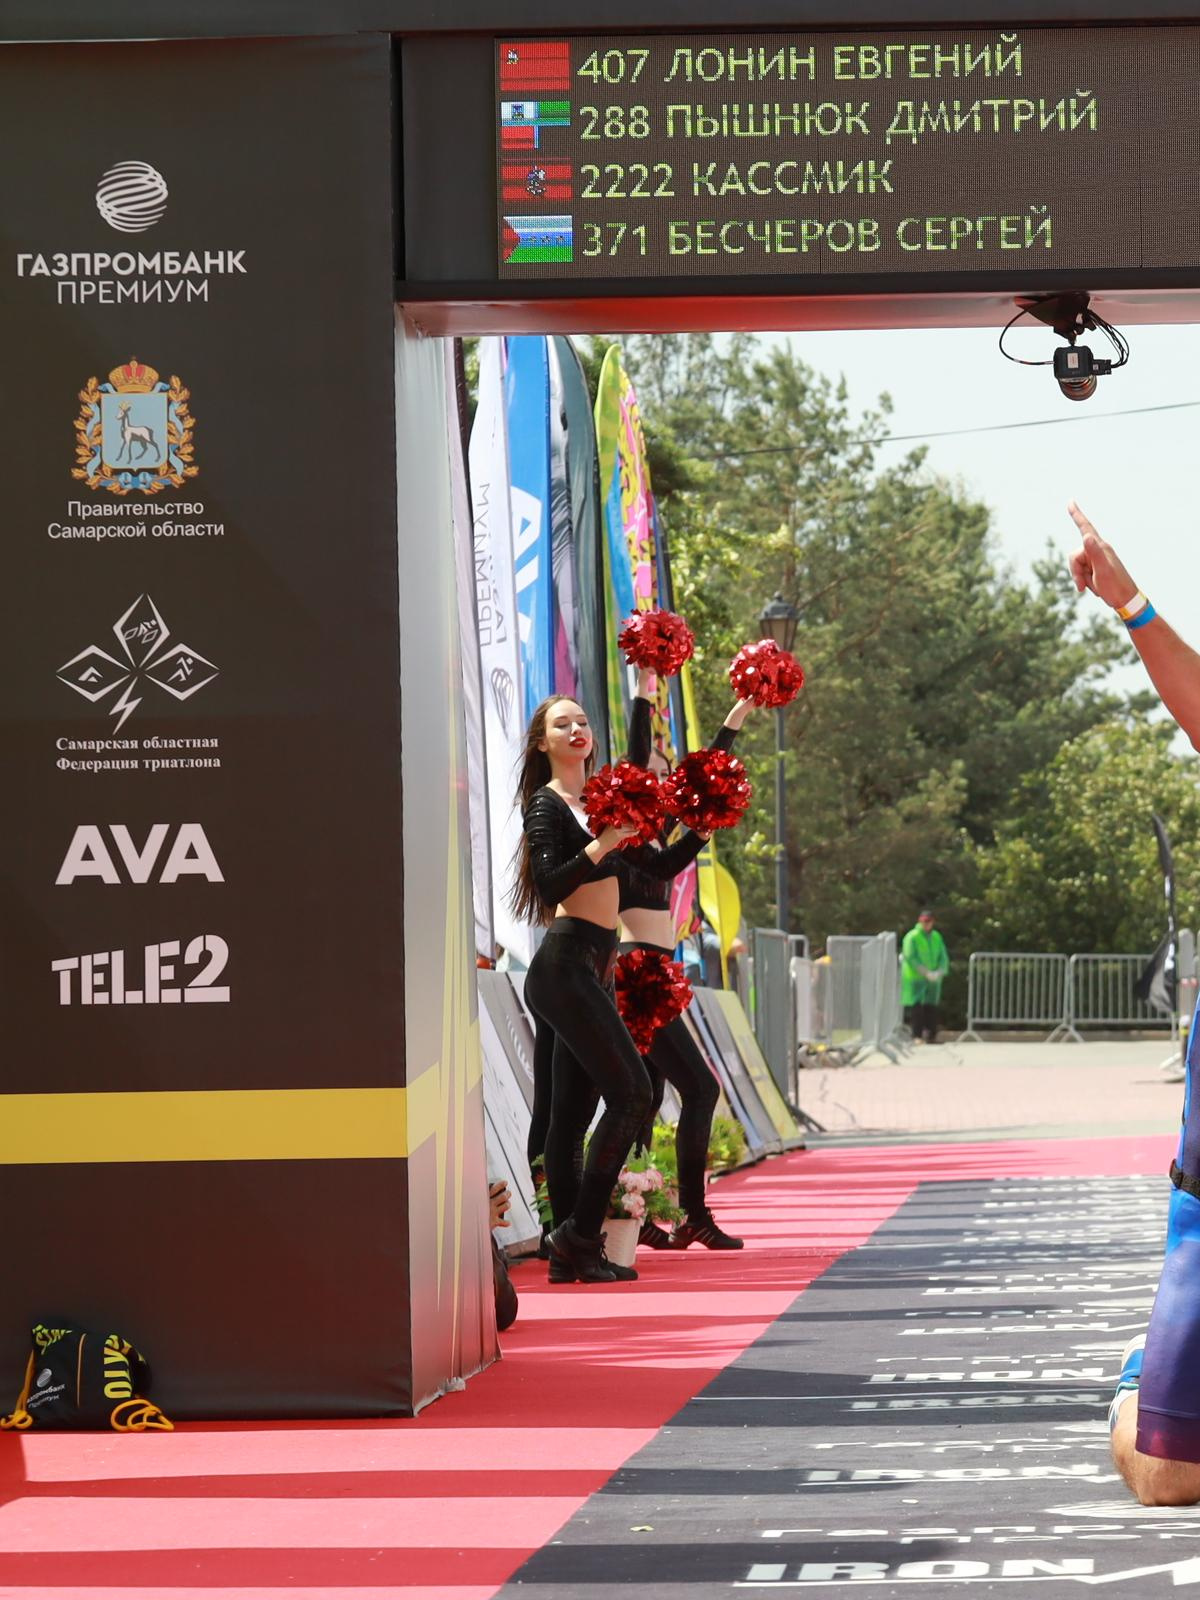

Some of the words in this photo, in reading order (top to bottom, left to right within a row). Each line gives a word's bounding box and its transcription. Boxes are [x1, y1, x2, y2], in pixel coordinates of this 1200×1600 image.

[577, 49, 650, 83] 407
[664, 46, 815, 83] ЛОНИН
[835, 33, 1023, 81] ЕВГЕНИЙ
[579, 104, 651, 140] 288
[666, 100, 870, 139] ПЫШНЮК
[886, 89, 1098, 144] ДМИТРИЙ
[580, 162, 675, 199] 2222
[693, 159, 894, 197] КАССМИК
[582, 222, 649, 257] 371
[668, 218, 881, 257] БЕСЧЕРОВ
[896, 205, 1054, 254] СЕРГЕЙ
[16, 250, 247, 278] ГАЗПРОМБАНК
[57, 279, 209, 304] ПРЕМИУМ
[67, 500, 204, 520] Правительство
[47, 520, 146, 542] Самарской
[151, 520, 225, 539] области
[55, 736, 139, 754] Самарская
[142, 735, 219, 750] областная
[55, 756, 139, 773] Федерация
[142, 755, 222, 771] триатлона
[55, 823, 225, 885] AVA
[51, 934, 230, 1006] TELE2
[804, 1464, 1100, 1482] IRON
[744, 1558, 1095, 1581] IRON
